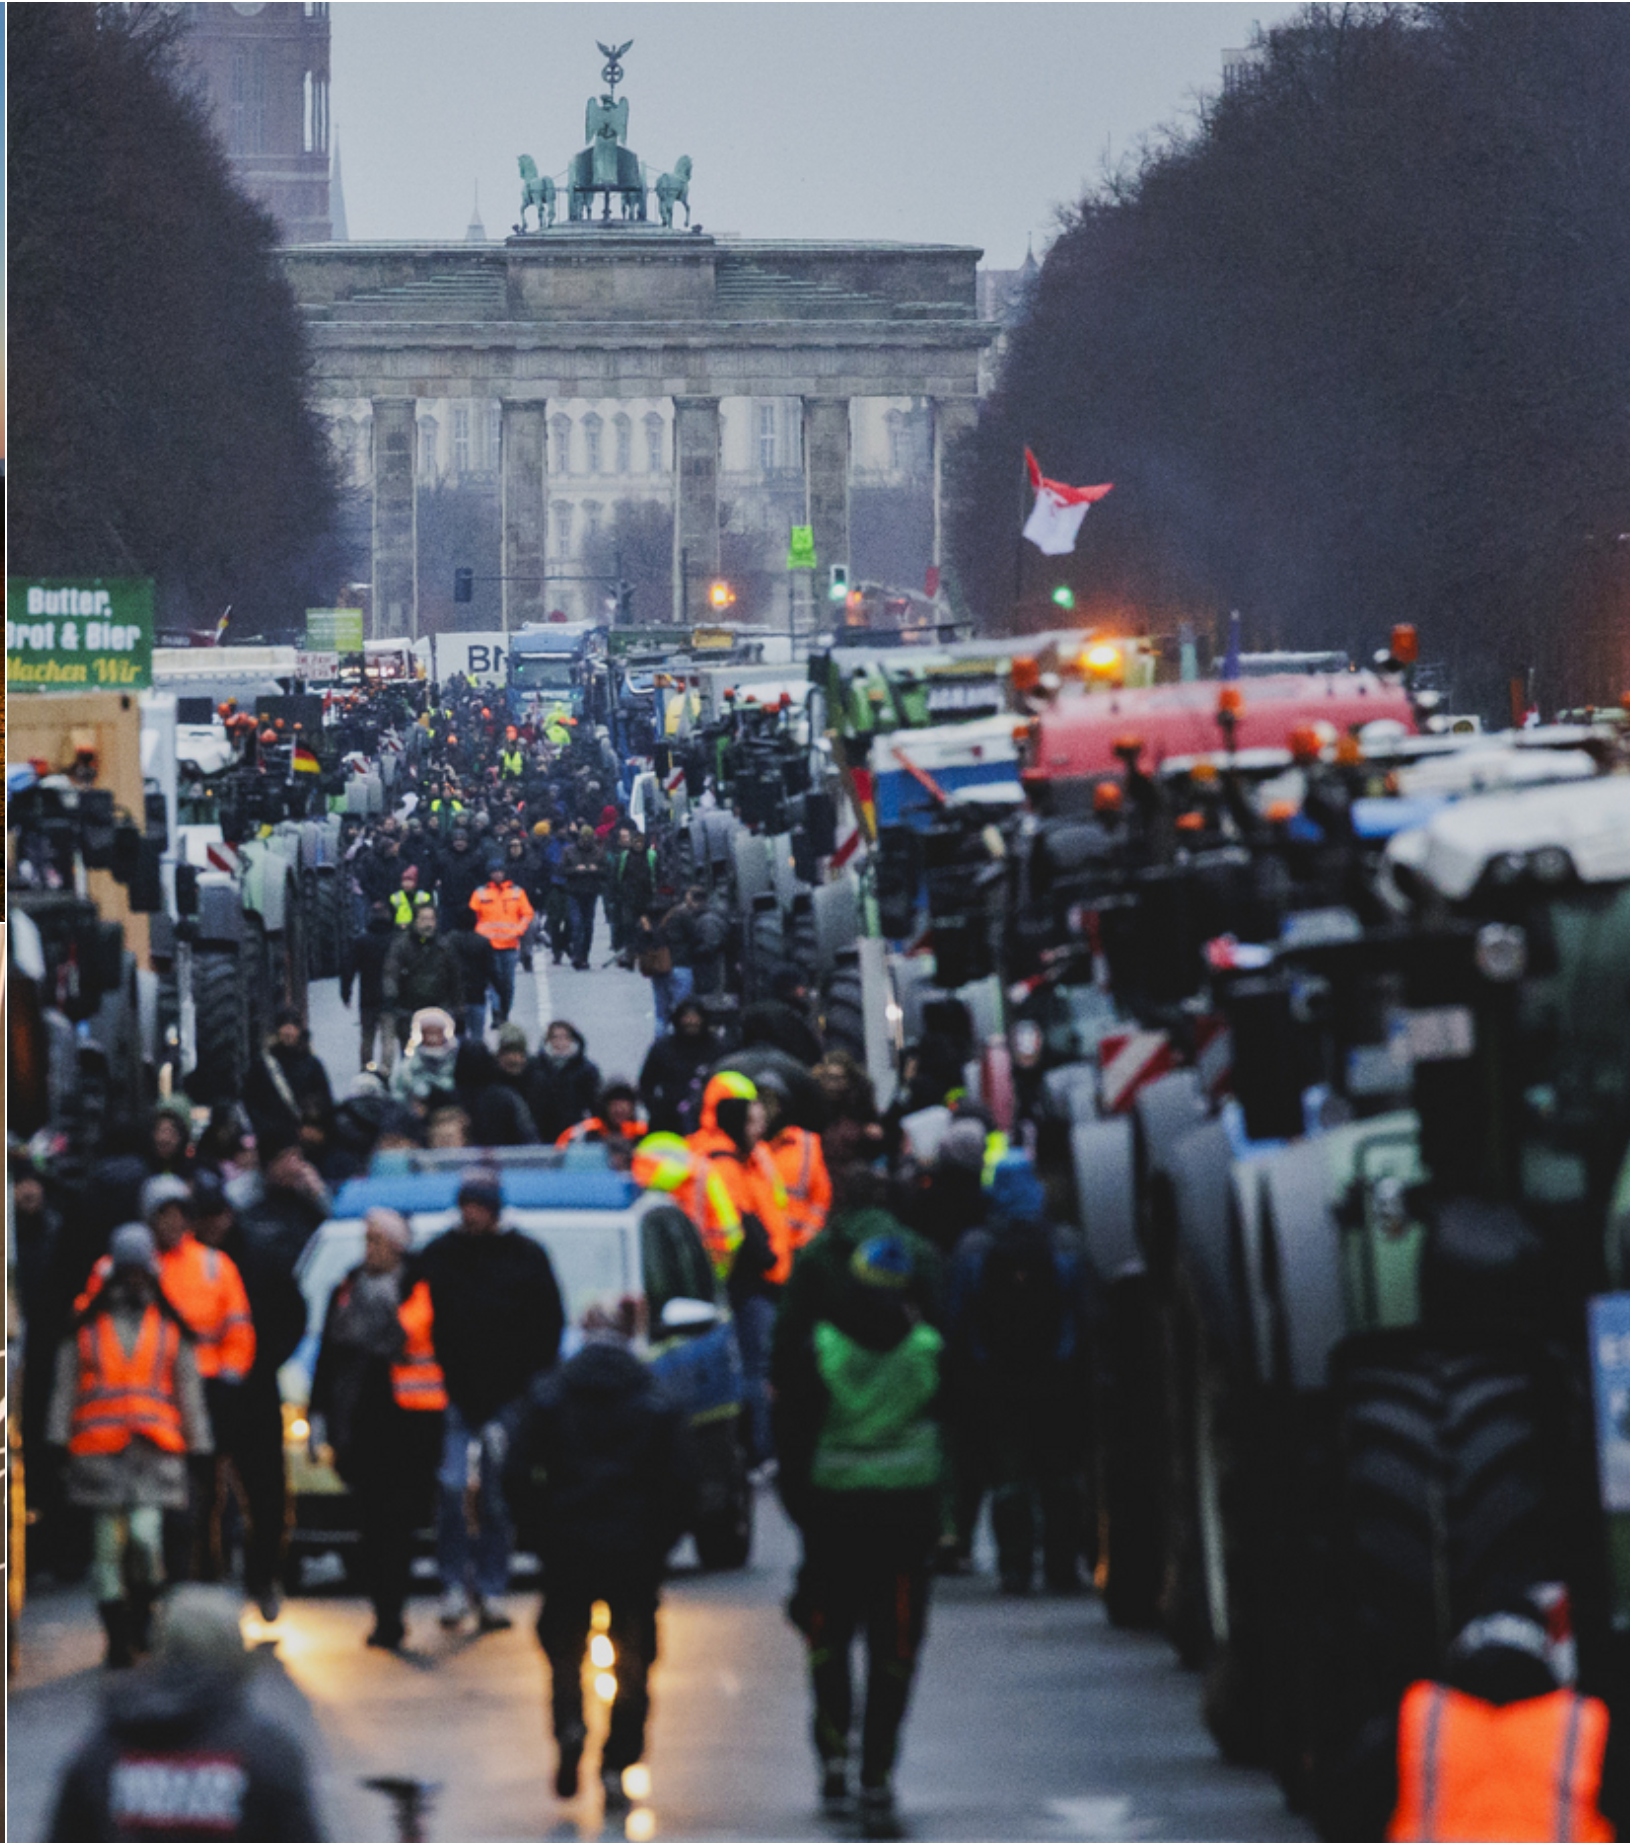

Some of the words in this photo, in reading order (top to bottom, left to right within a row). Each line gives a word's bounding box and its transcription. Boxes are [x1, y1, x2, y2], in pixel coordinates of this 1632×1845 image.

[60, 621, 79, 650] &
[85, 621, 141, 650] Bier
[92, 657, 142, 683] Wir
